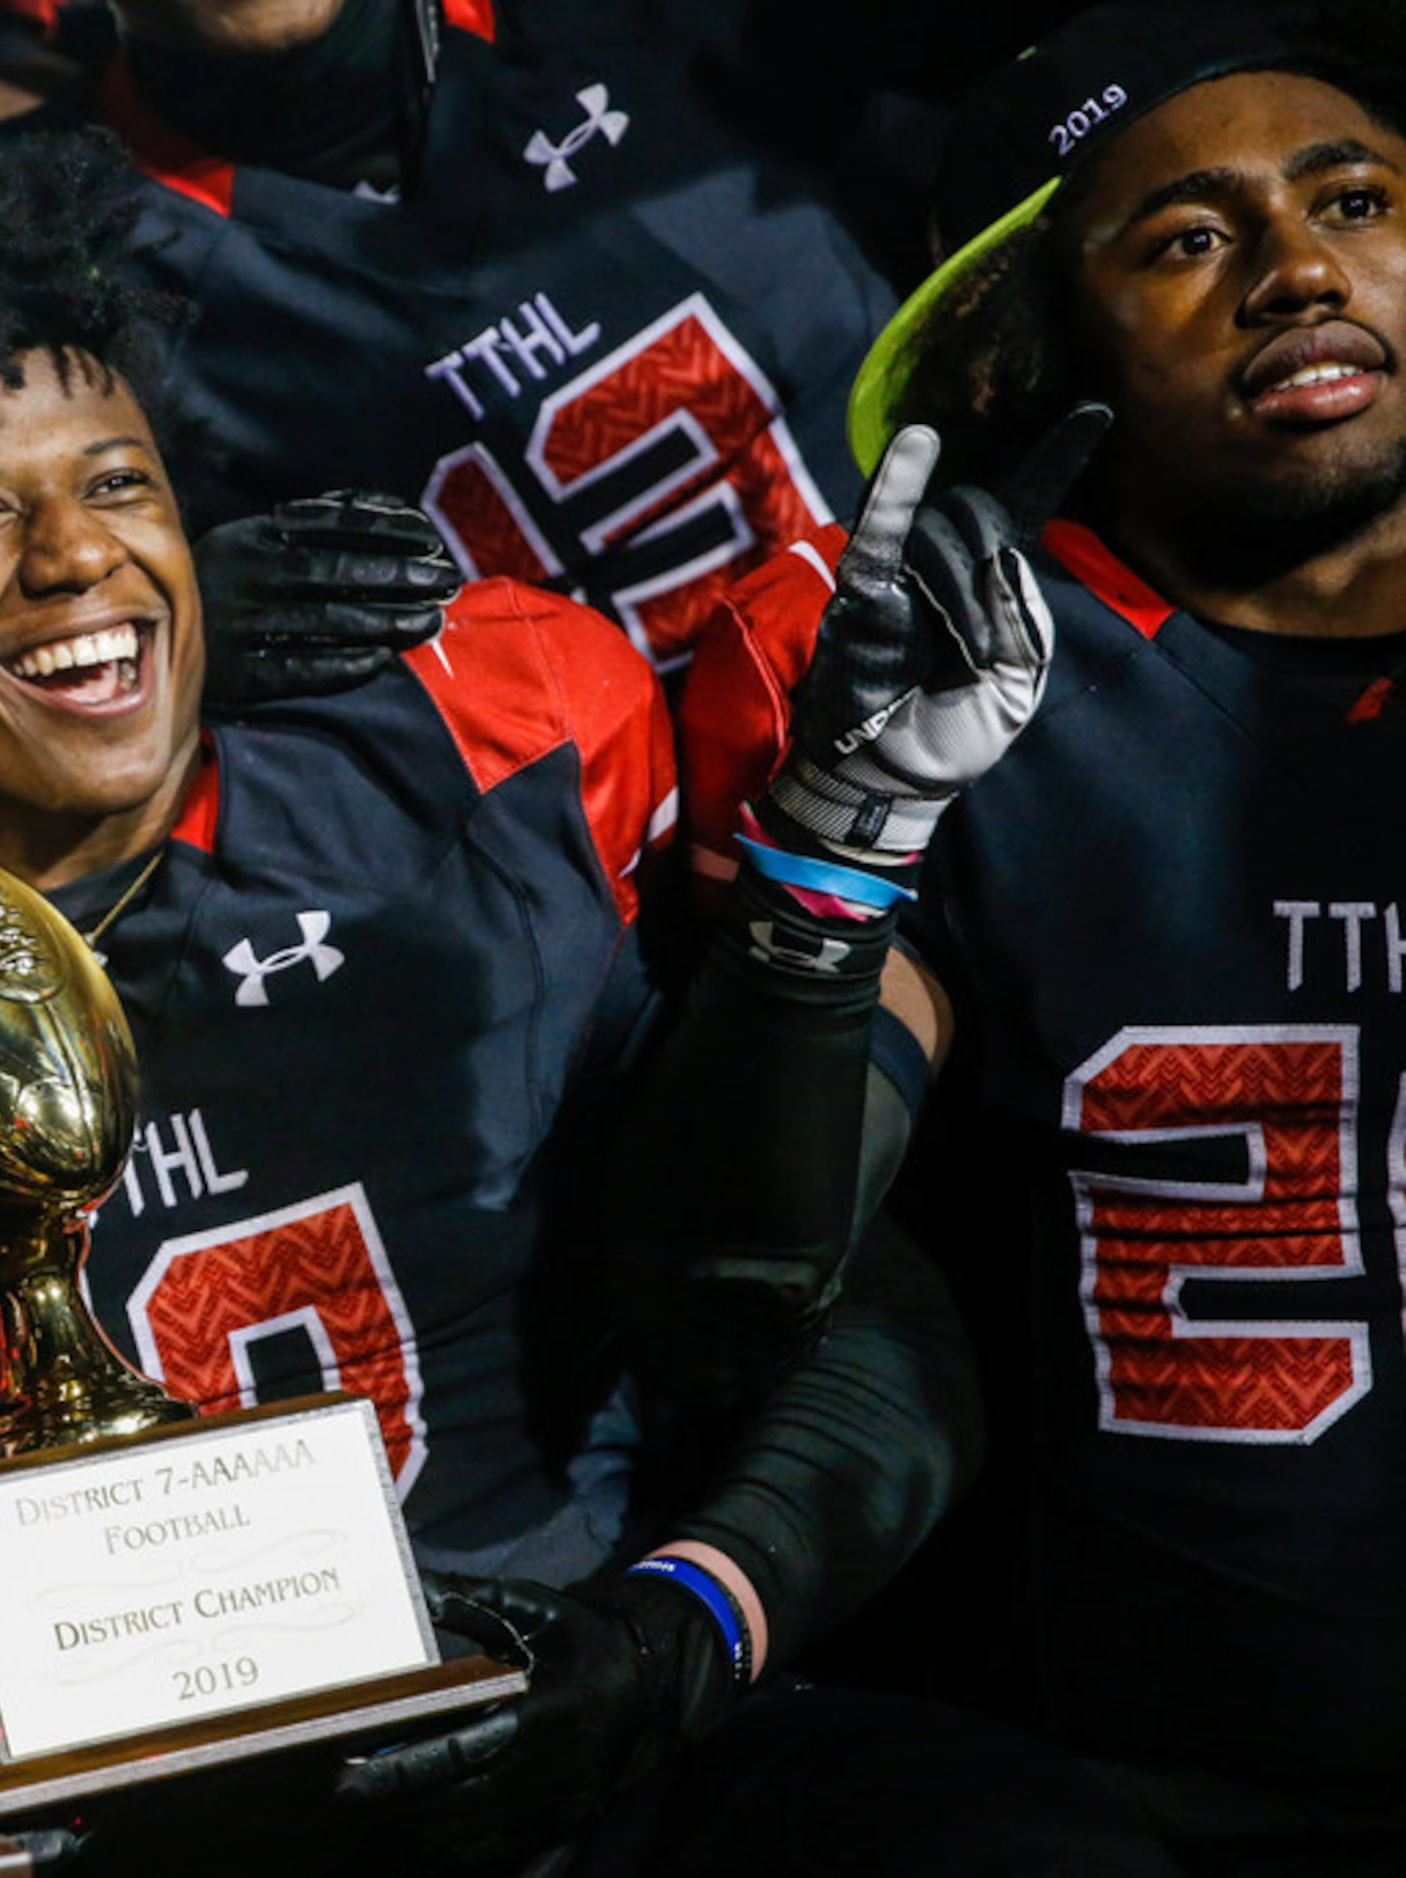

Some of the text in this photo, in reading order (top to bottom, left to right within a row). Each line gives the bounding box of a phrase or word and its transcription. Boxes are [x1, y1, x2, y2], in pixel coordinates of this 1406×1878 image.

[1048, 84, 1128, 156] 2019
[425, 292, 600, 421] TTHL
[1060, 1024, 1406, 1446] 2
[15, 1479, 144, 1527] DISTRICT
[104, 1504, 250, 1554] FOOTBALL
[52, 1566, 341, 1651] DISTRICT CHAMPION
[172, 1656, 260, 1701] 2019
